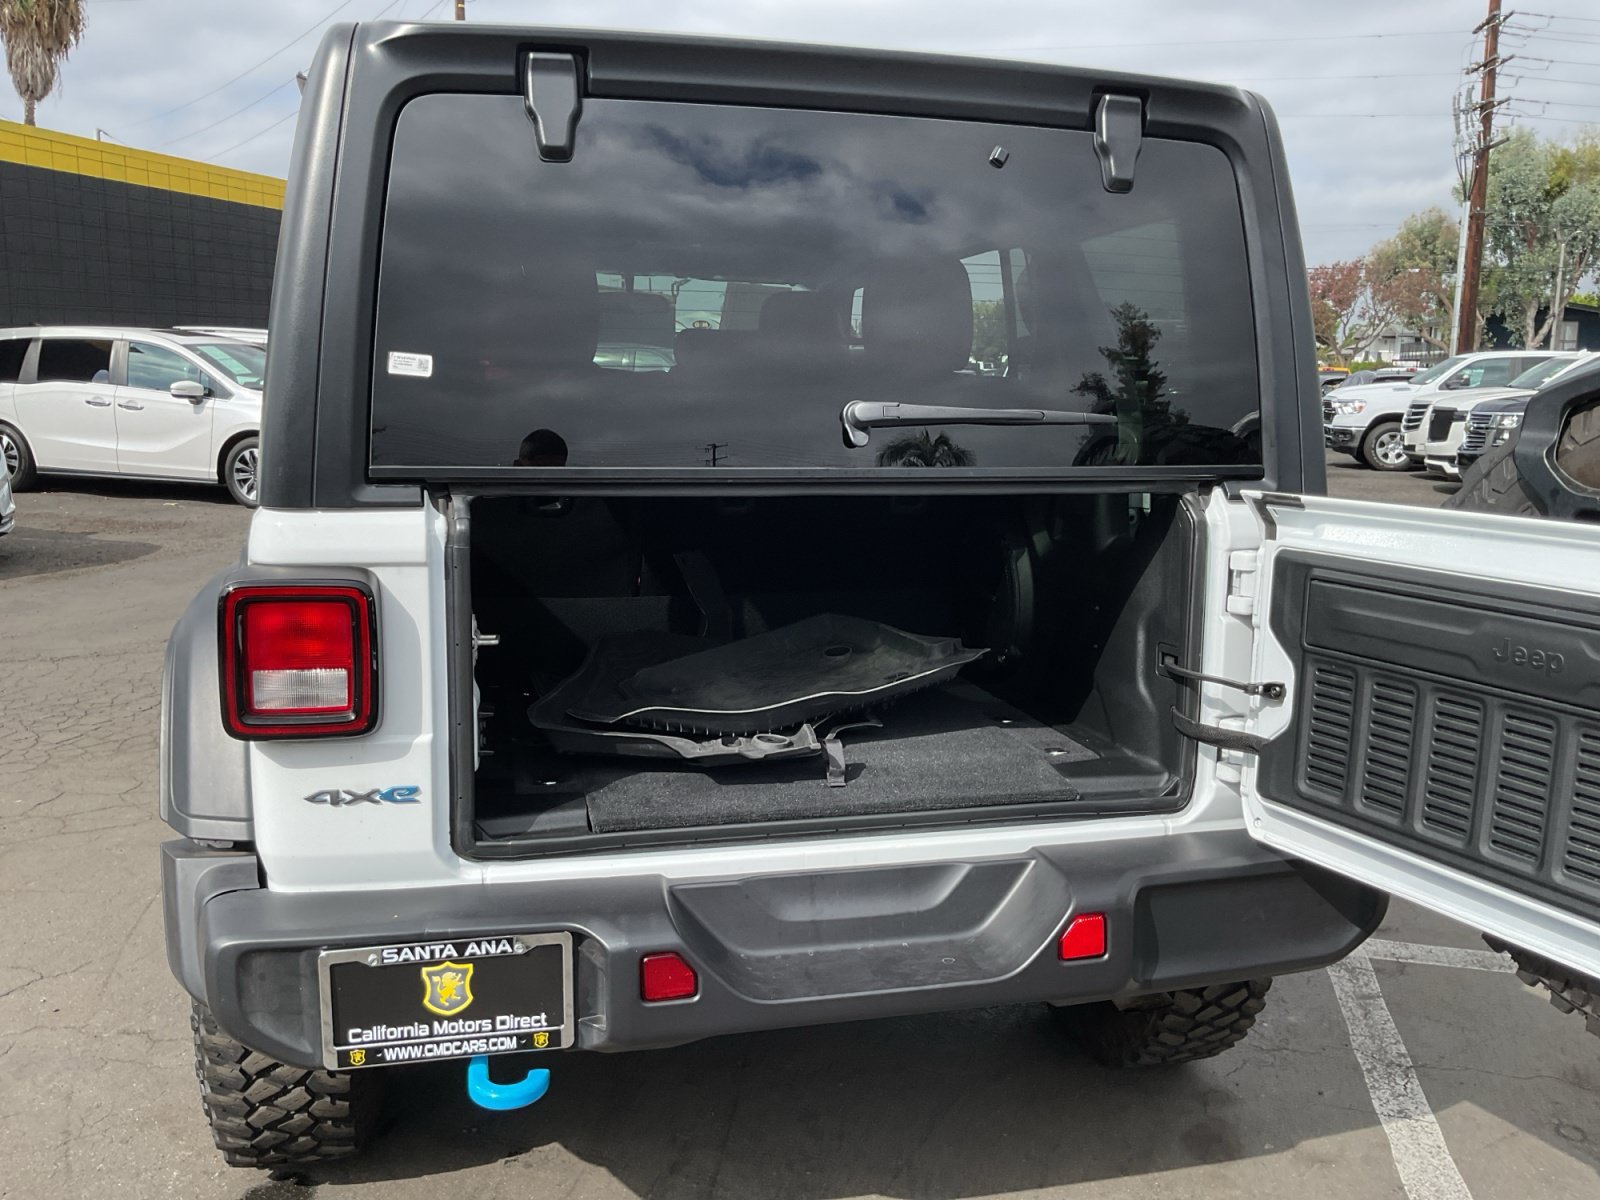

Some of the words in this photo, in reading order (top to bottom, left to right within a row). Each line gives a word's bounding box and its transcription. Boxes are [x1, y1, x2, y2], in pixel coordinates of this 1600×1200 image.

[1492, 636, 1565, 678] Jeep
[382, 943, 459, 963] SANTA
[464, 939, 513, 956] ANA
[348, 1024, 430, 1044] California
[433, 1017, 492, 1037] Motors
[495, 1012, 548, 1030] Direct
[384, 1037, 517, 1061] WWW.CMDCARS.COM
